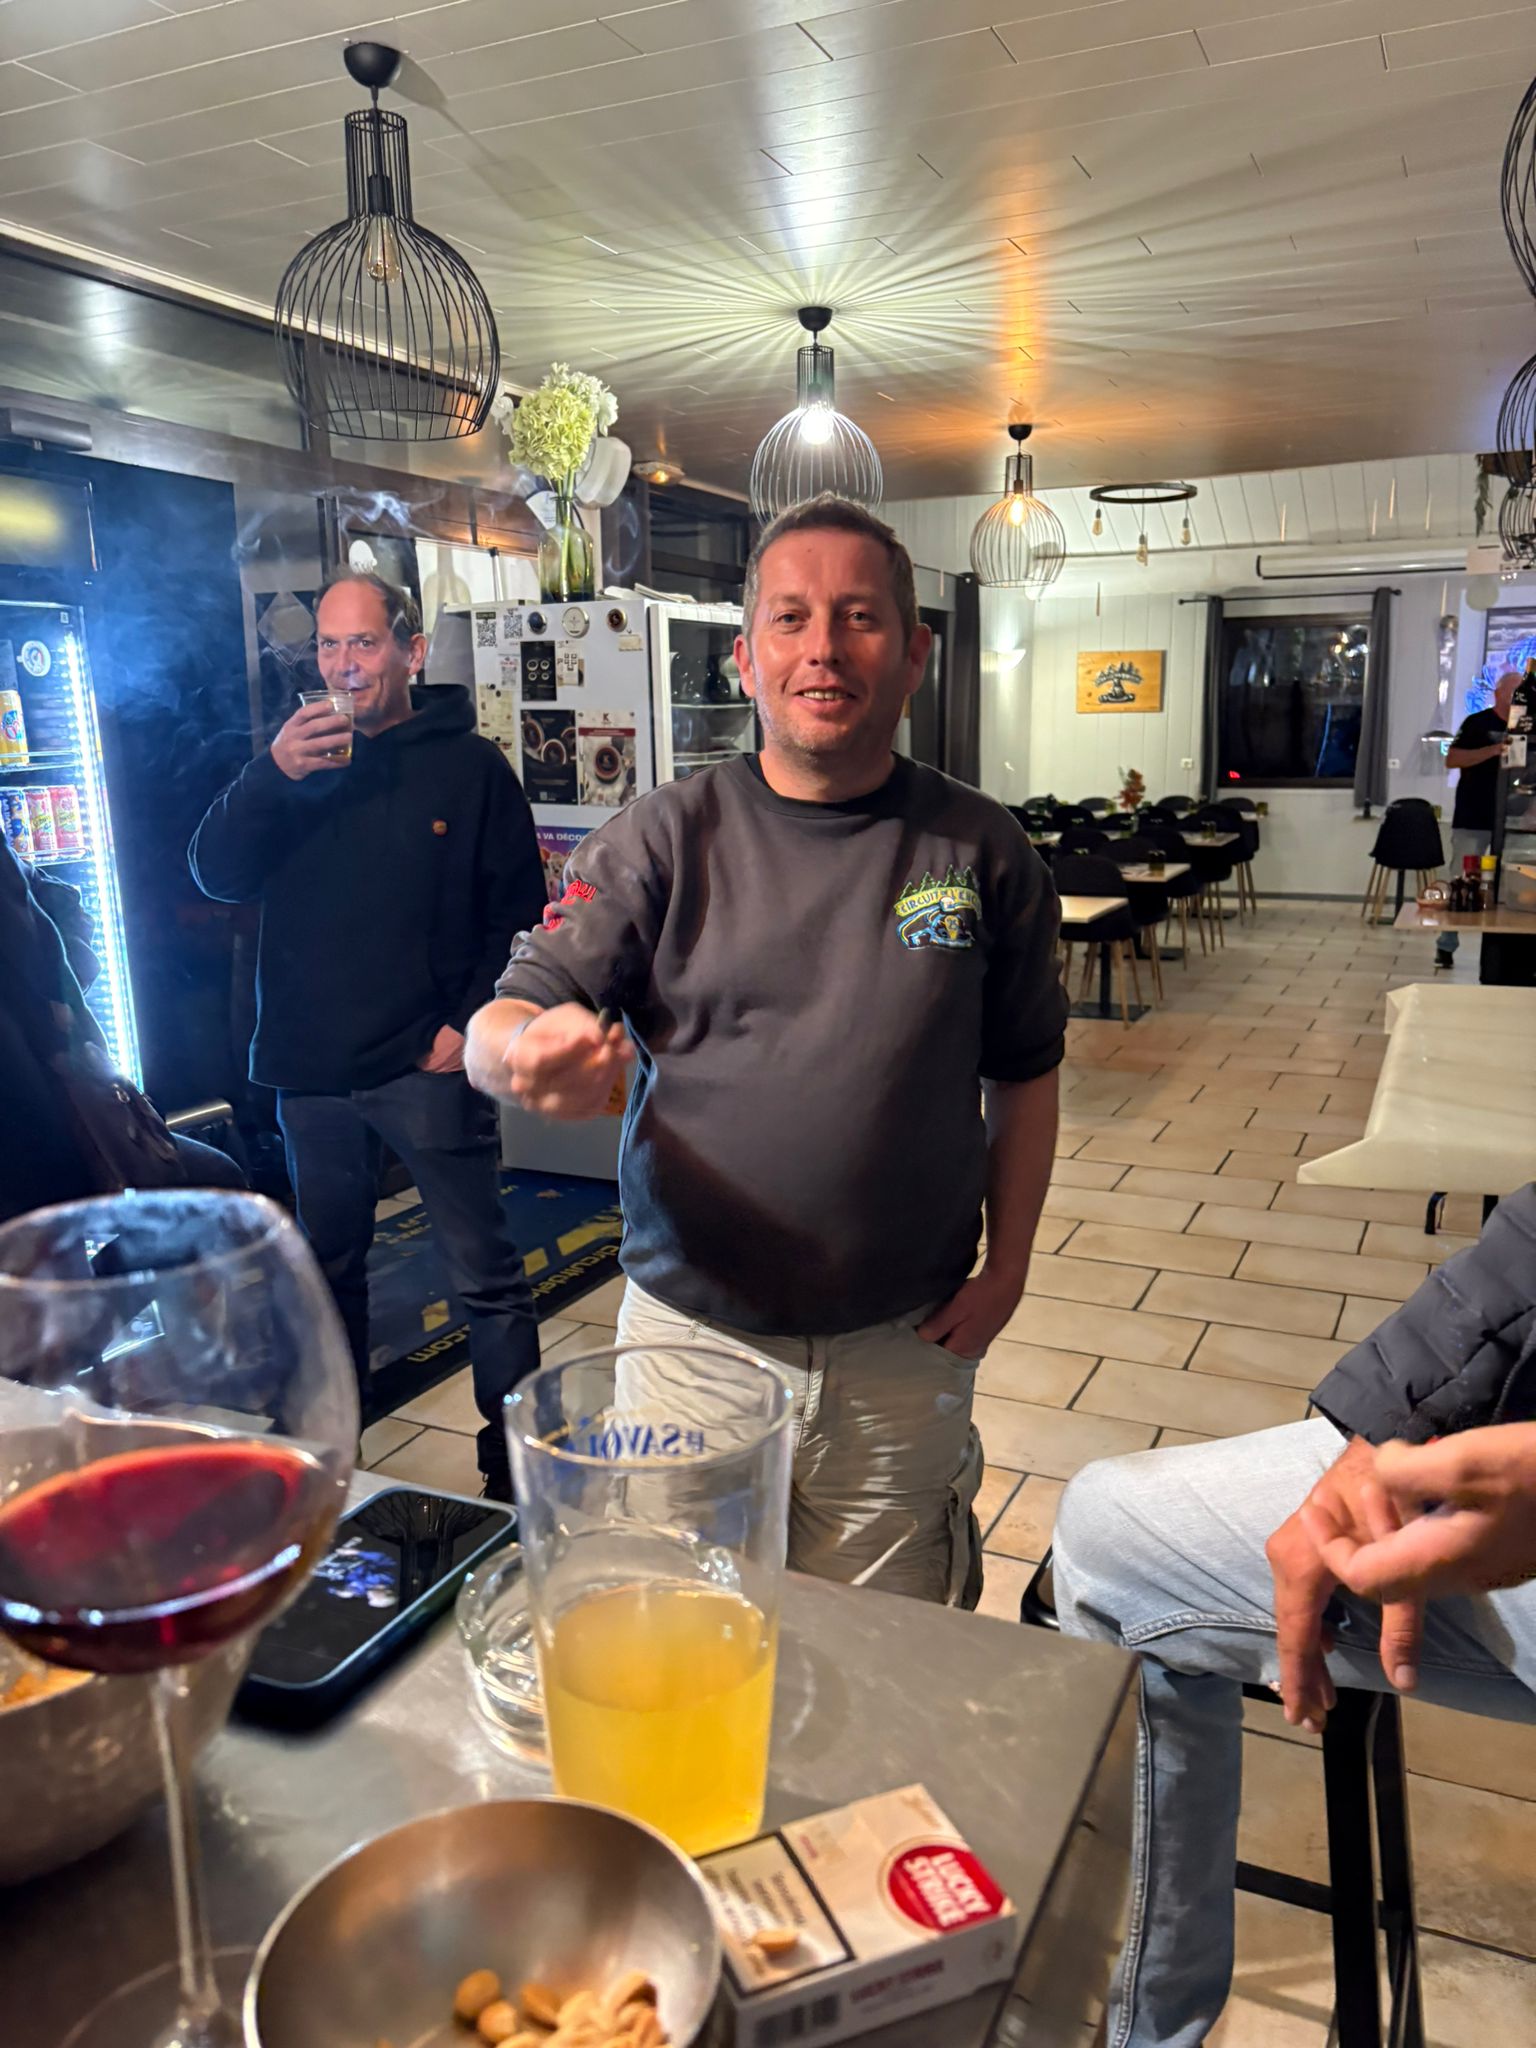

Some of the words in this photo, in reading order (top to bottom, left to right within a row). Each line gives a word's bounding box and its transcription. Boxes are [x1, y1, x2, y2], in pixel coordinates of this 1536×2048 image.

[899, 890, 939, 914] CIRCUIT
[903, 1855, 968, 1929] STRIKE
[931, 1851, 992, 1914] LUCKY
